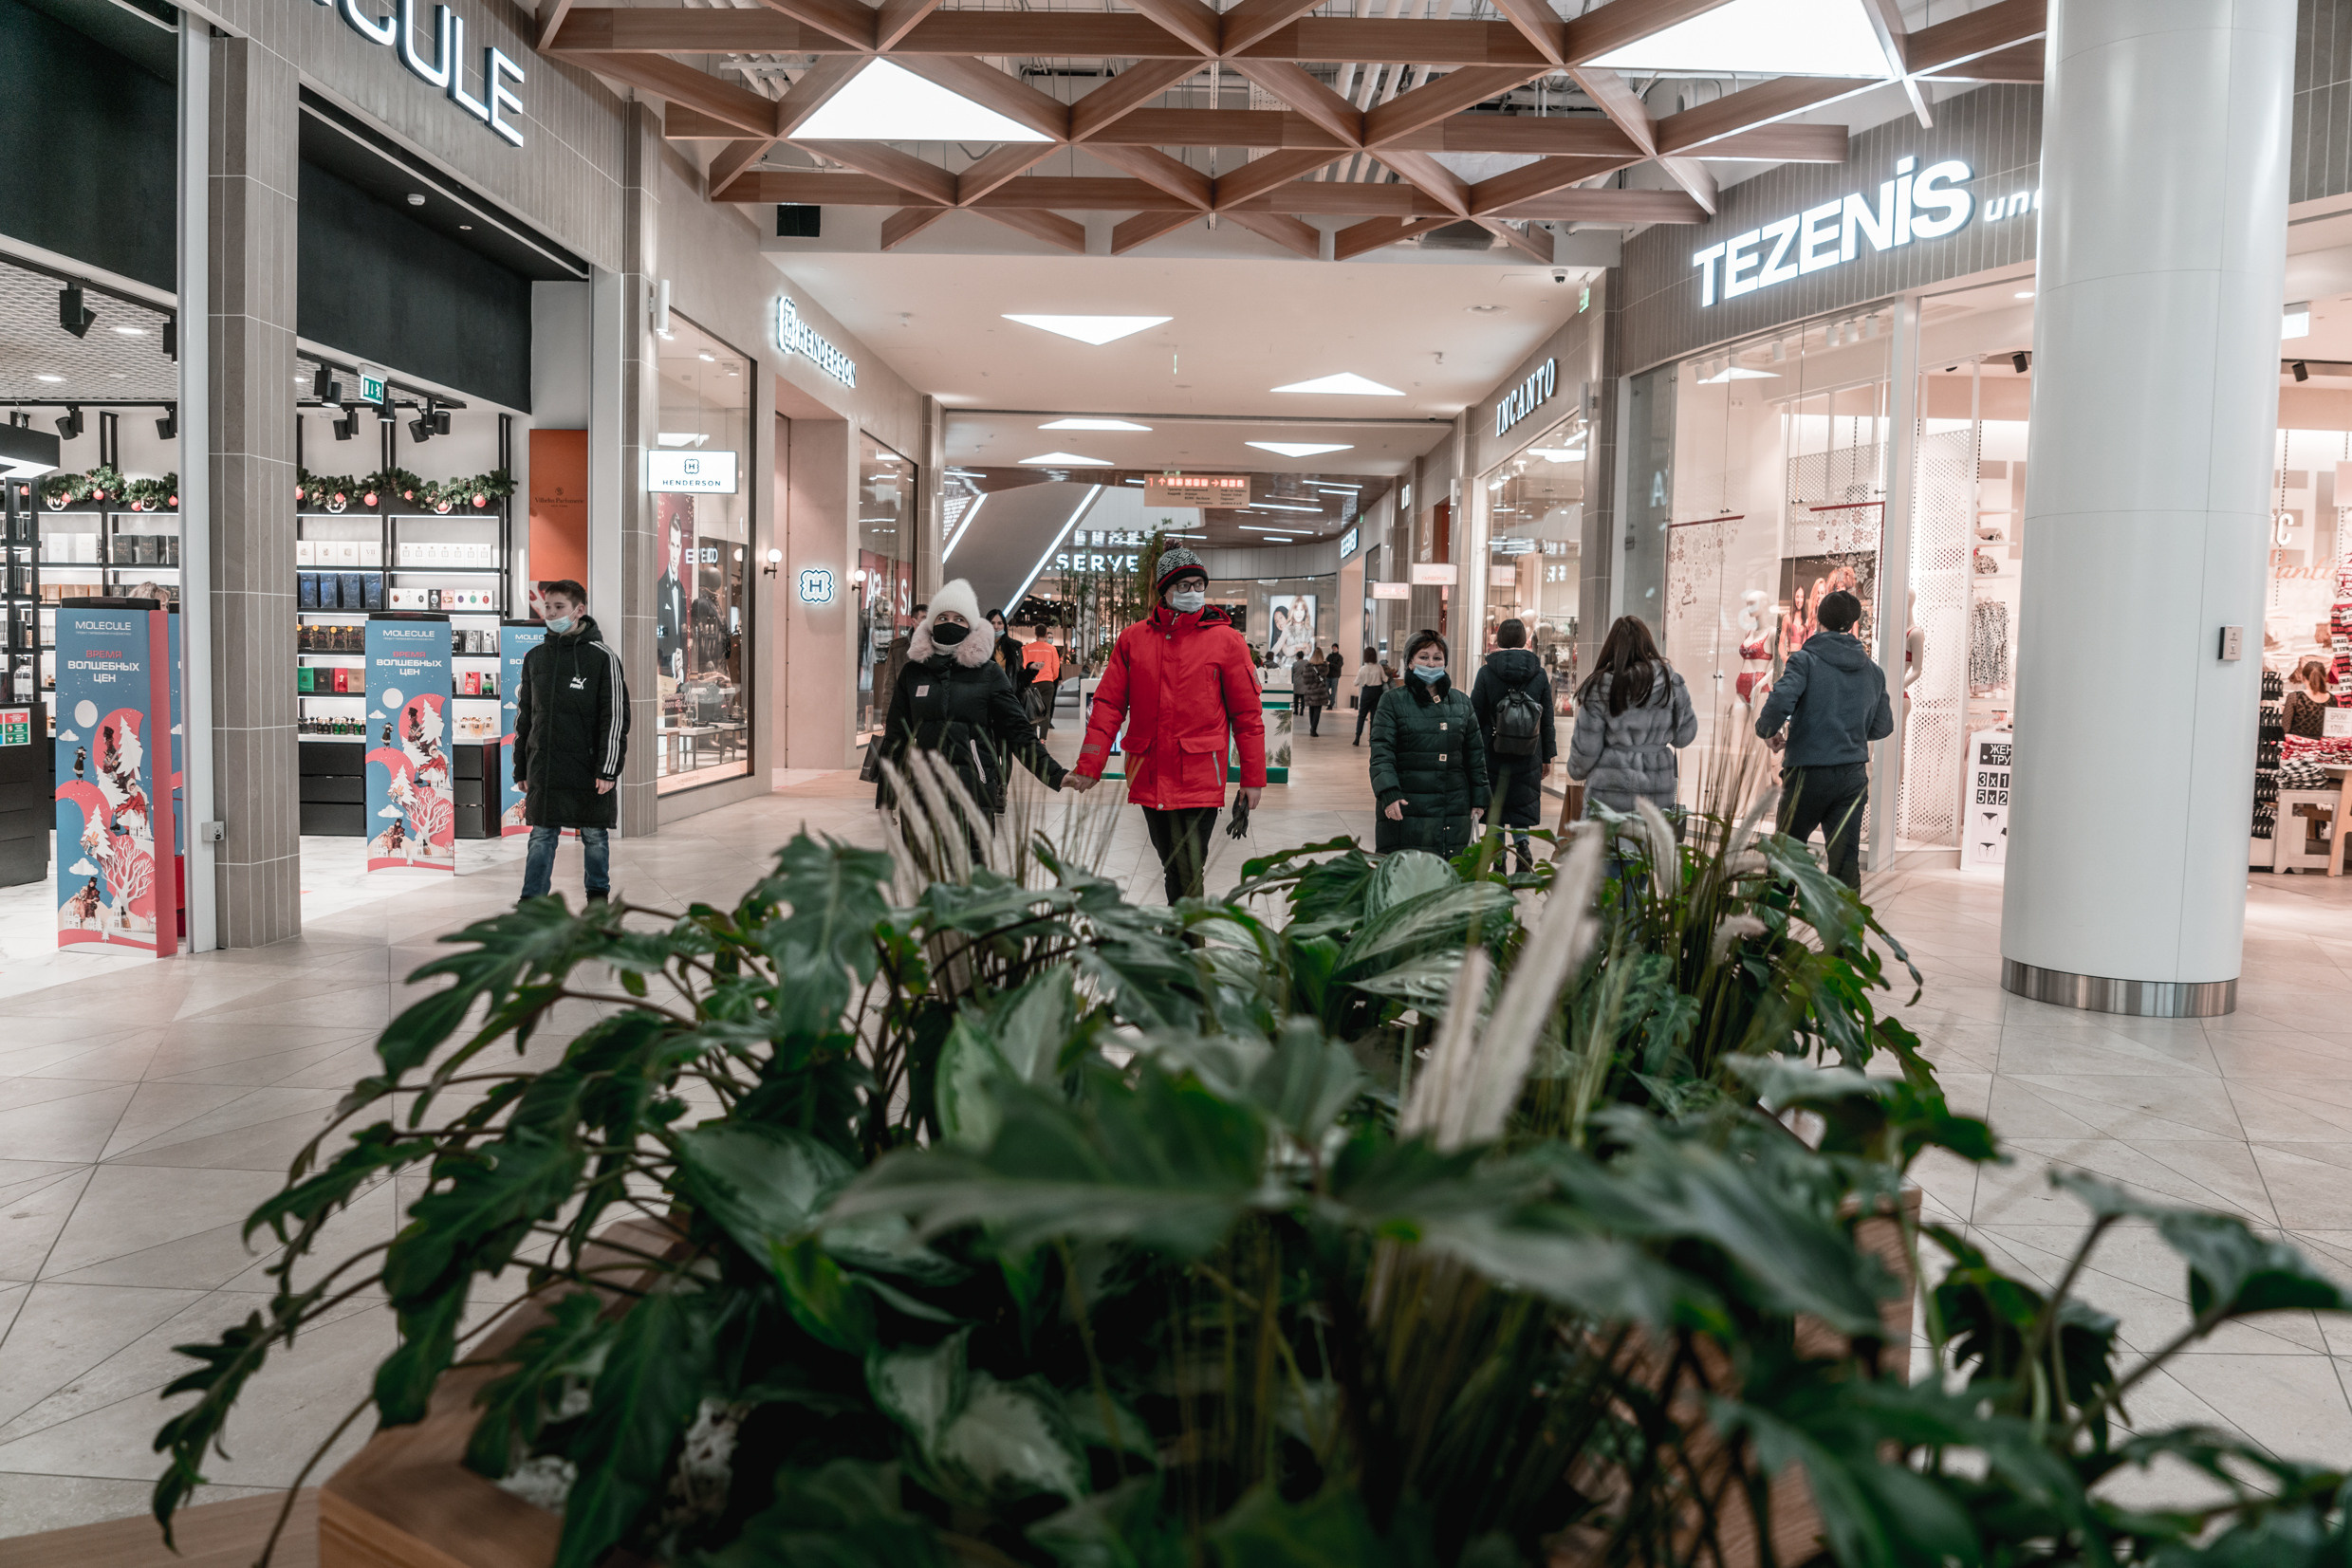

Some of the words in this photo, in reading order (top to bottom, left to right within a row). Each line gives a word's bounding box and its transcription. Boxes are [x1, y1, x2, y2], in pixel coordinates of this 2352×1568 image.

[796, 319, 856, 389] HENDERSON
[1495, 357, 1555, 437] INCANTO
[75, 621, 132, 631] MOLECULE
[85, 650, 122, 659] ВРЕМЯ
[67, 660, 140, 672] ВОЛШЕБНЫХ
[376, 658, 442, 667] ВОЛШЕБНЫХ
[399, 668, 420, 676] ЦЕН
[93, 673, 116, 684] ЦЕН
